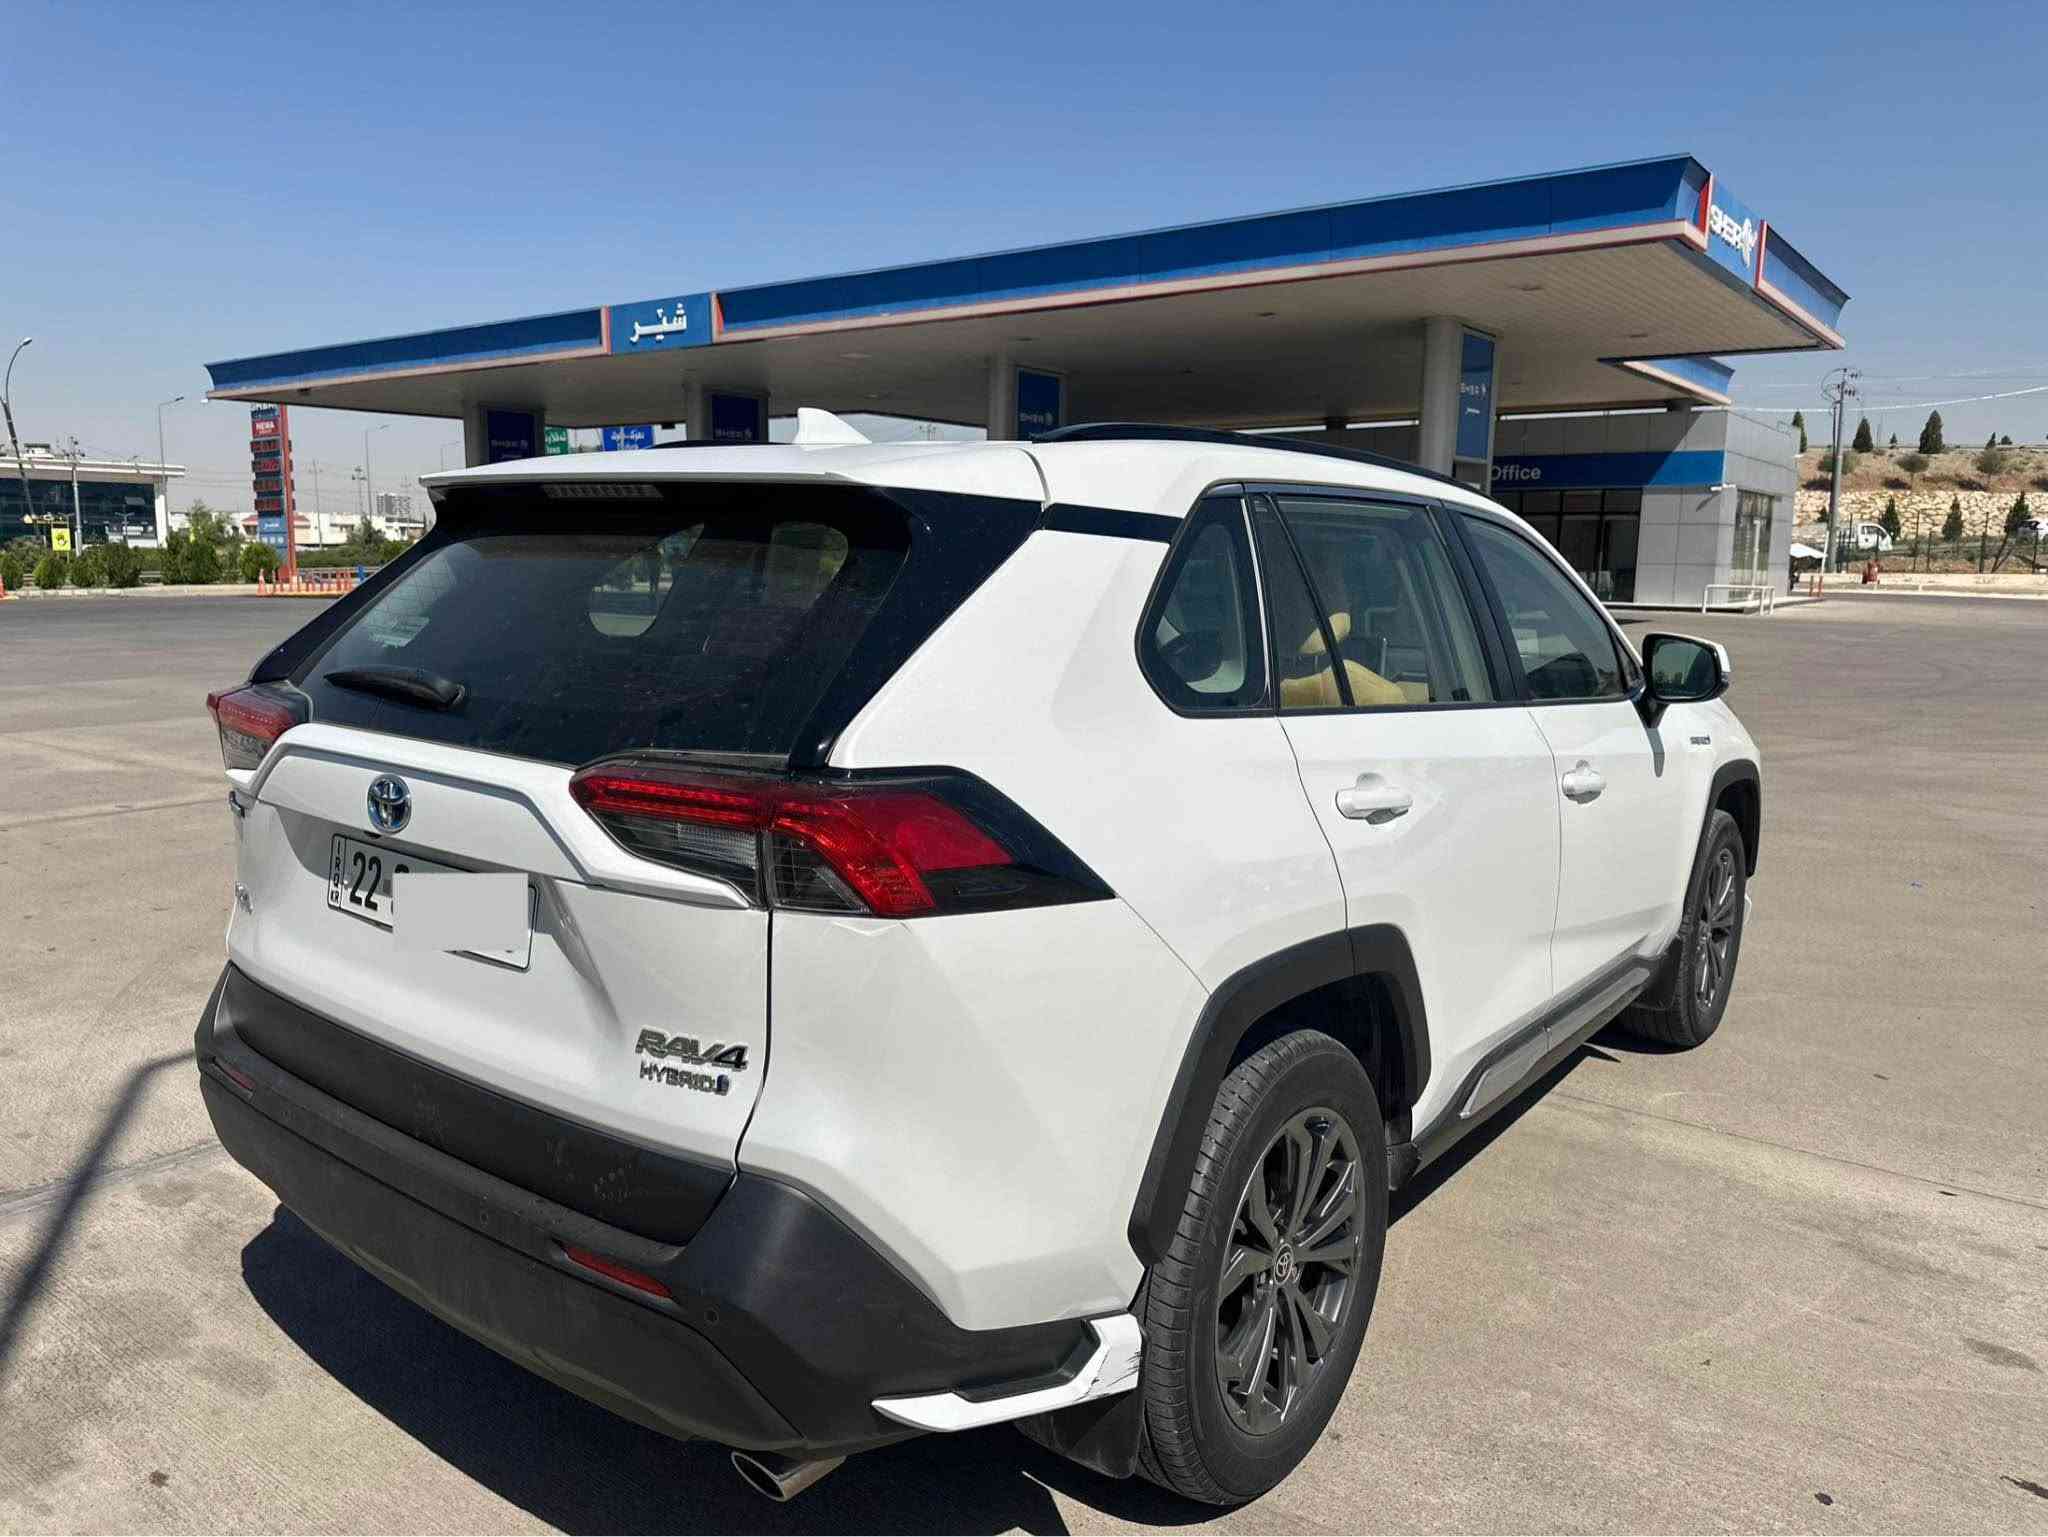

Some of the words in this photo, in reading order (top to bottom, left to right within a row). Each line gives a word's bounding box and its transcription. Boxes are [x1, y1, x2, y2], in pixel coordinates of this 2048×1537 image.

[1710, 204, 1744, 249] SHER
[1491, 464, 1542, 480] Office
[349, 851, 382, 911] 22
[635, 1027, 749, 1072] RAV4
[640, 1060, 716, 1093] HYBRID
